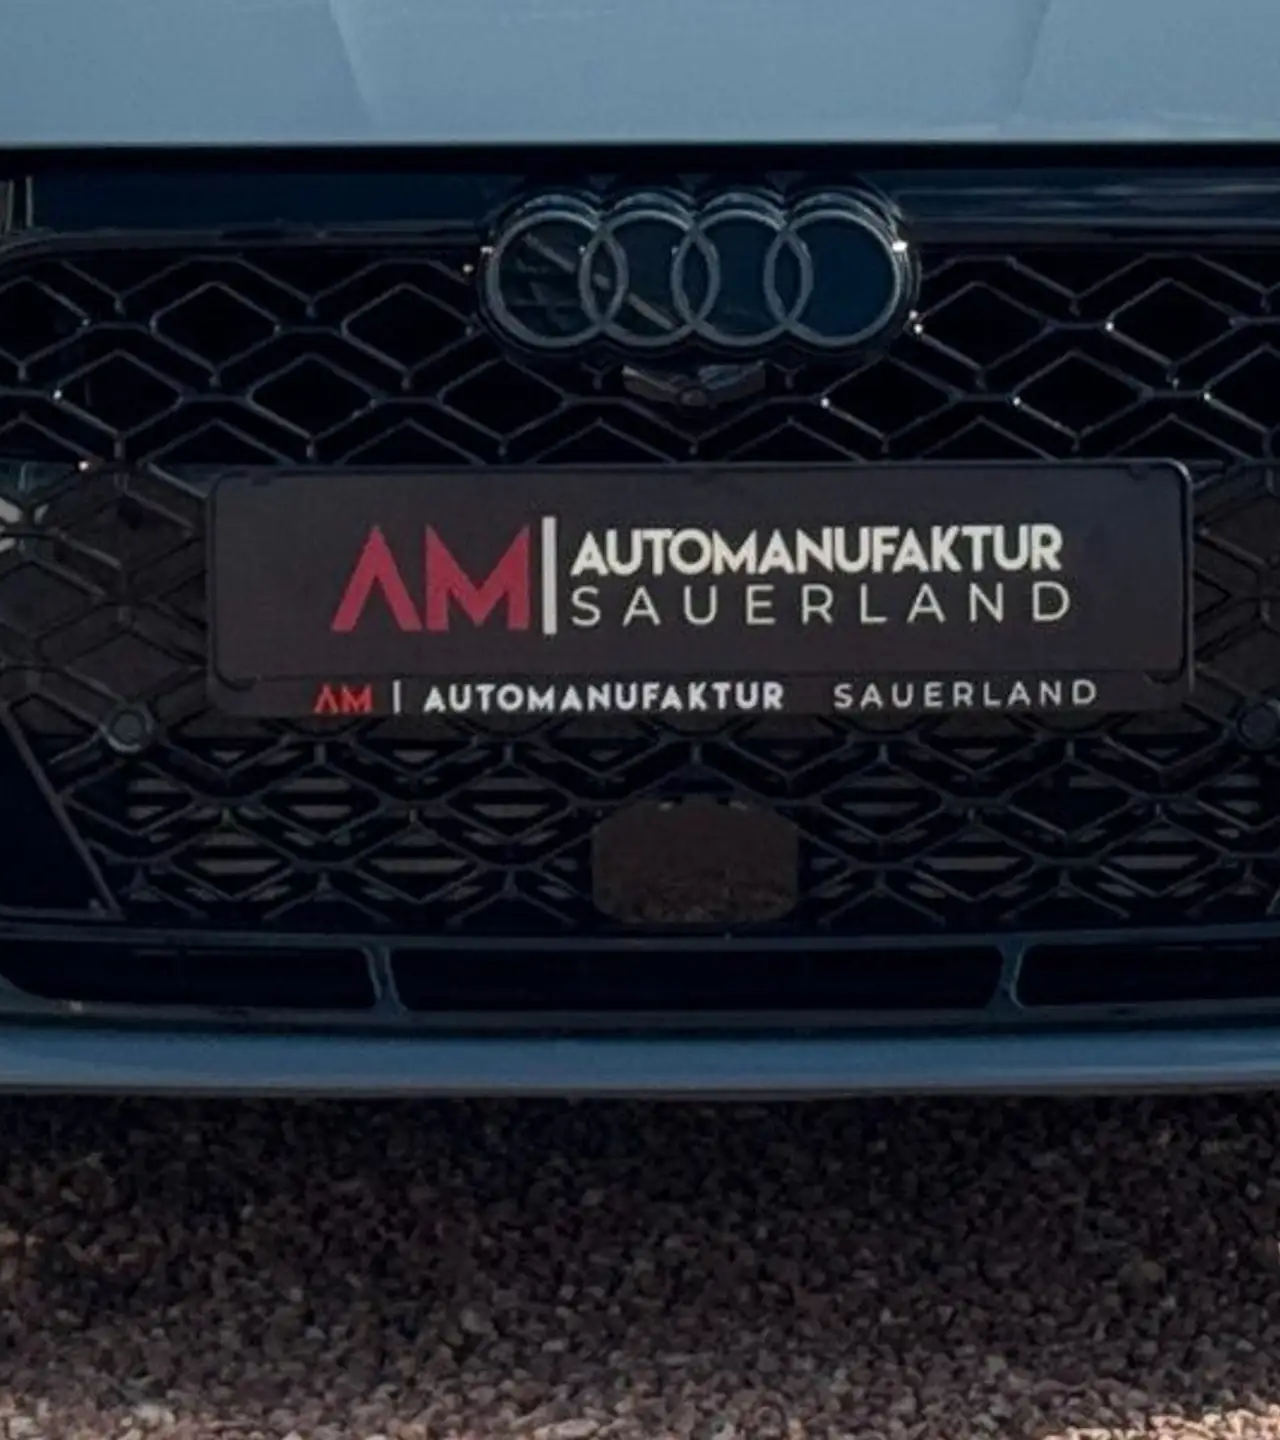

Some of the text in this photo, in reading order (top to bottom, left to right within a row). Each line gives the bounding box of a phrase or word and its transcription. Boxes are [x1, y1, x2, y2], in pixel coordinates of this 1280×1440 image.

[570, 522, 1064, 577] AUTOMANUFAKTUR
[331, 528, 530, 633] AM
[570, 580, 1071, 627] SAUERLAND
[314, 679, 1097, 713] AM AUTOMANUFAKTUR SAUERLAND
